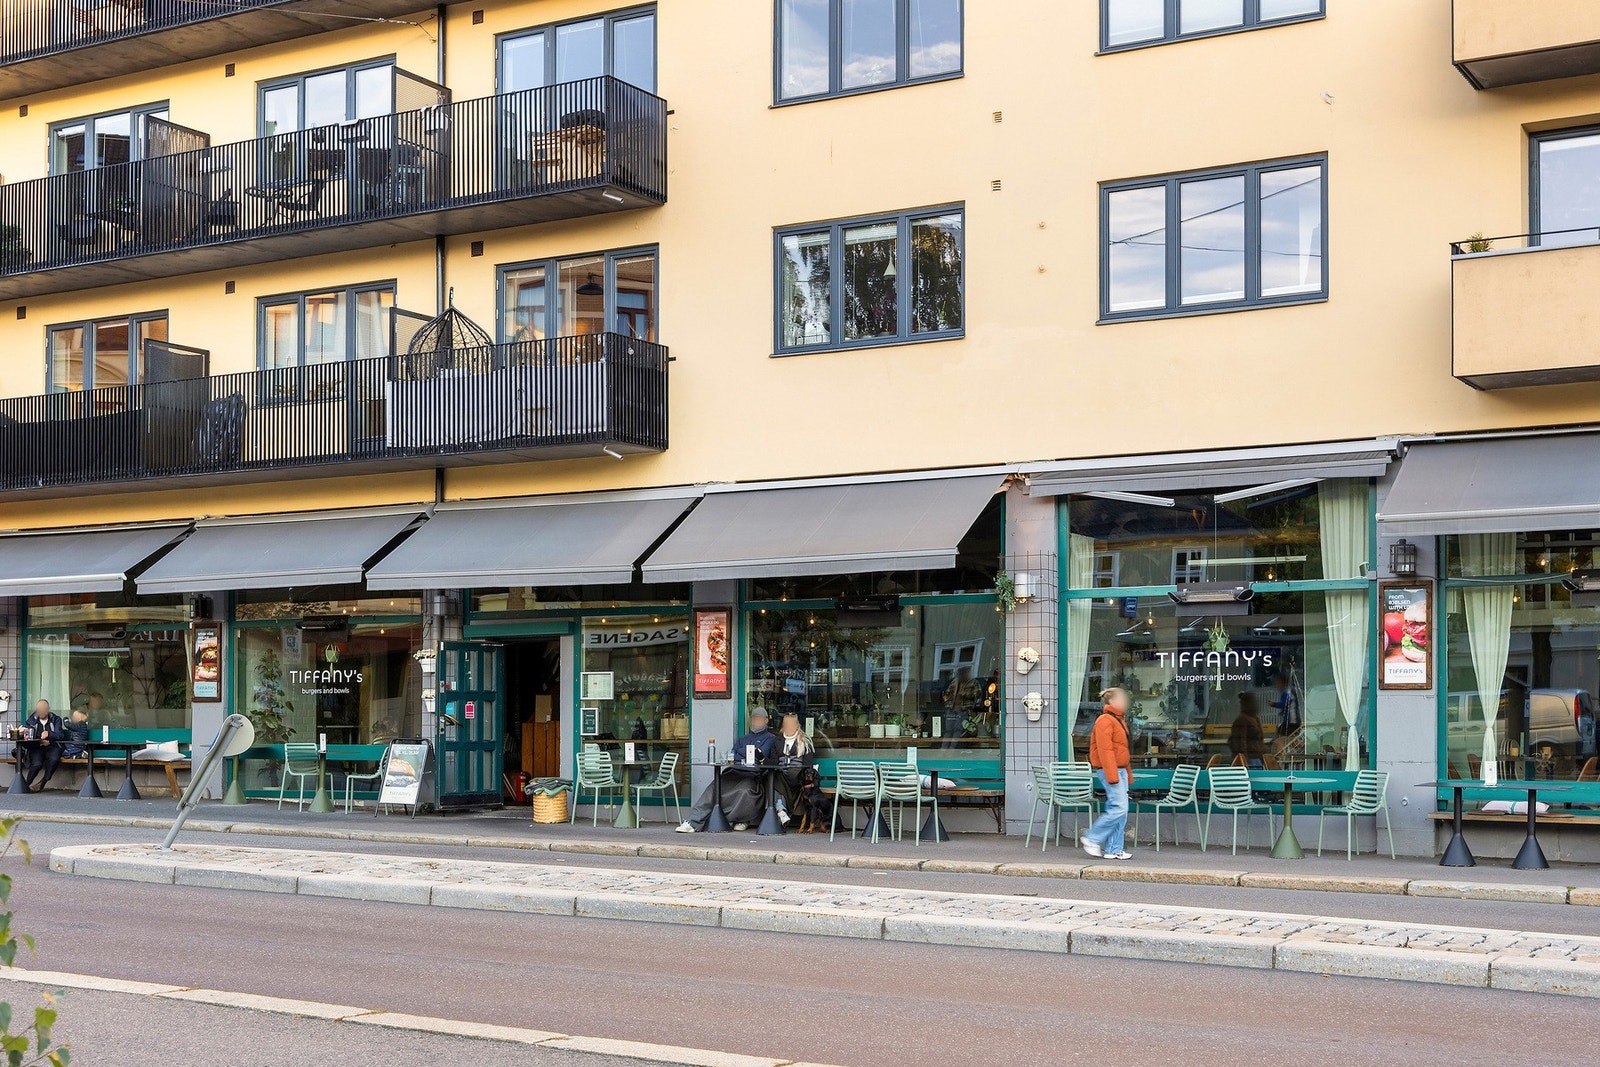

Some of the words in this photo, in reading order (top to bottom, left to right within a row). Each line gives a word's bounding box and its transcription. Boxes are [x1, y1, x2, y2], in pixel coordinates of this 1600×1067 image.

[1155, 650, 1273, 668] TIFFANY's
[289, 669, 363, 683] TIFFANY's
[1175, 674, 1208, 683] burgers
[1208, 673, 1225, 681] and
[1226, 673, 1252, 681] bowls
[301, 687, 322, 695] burgers
